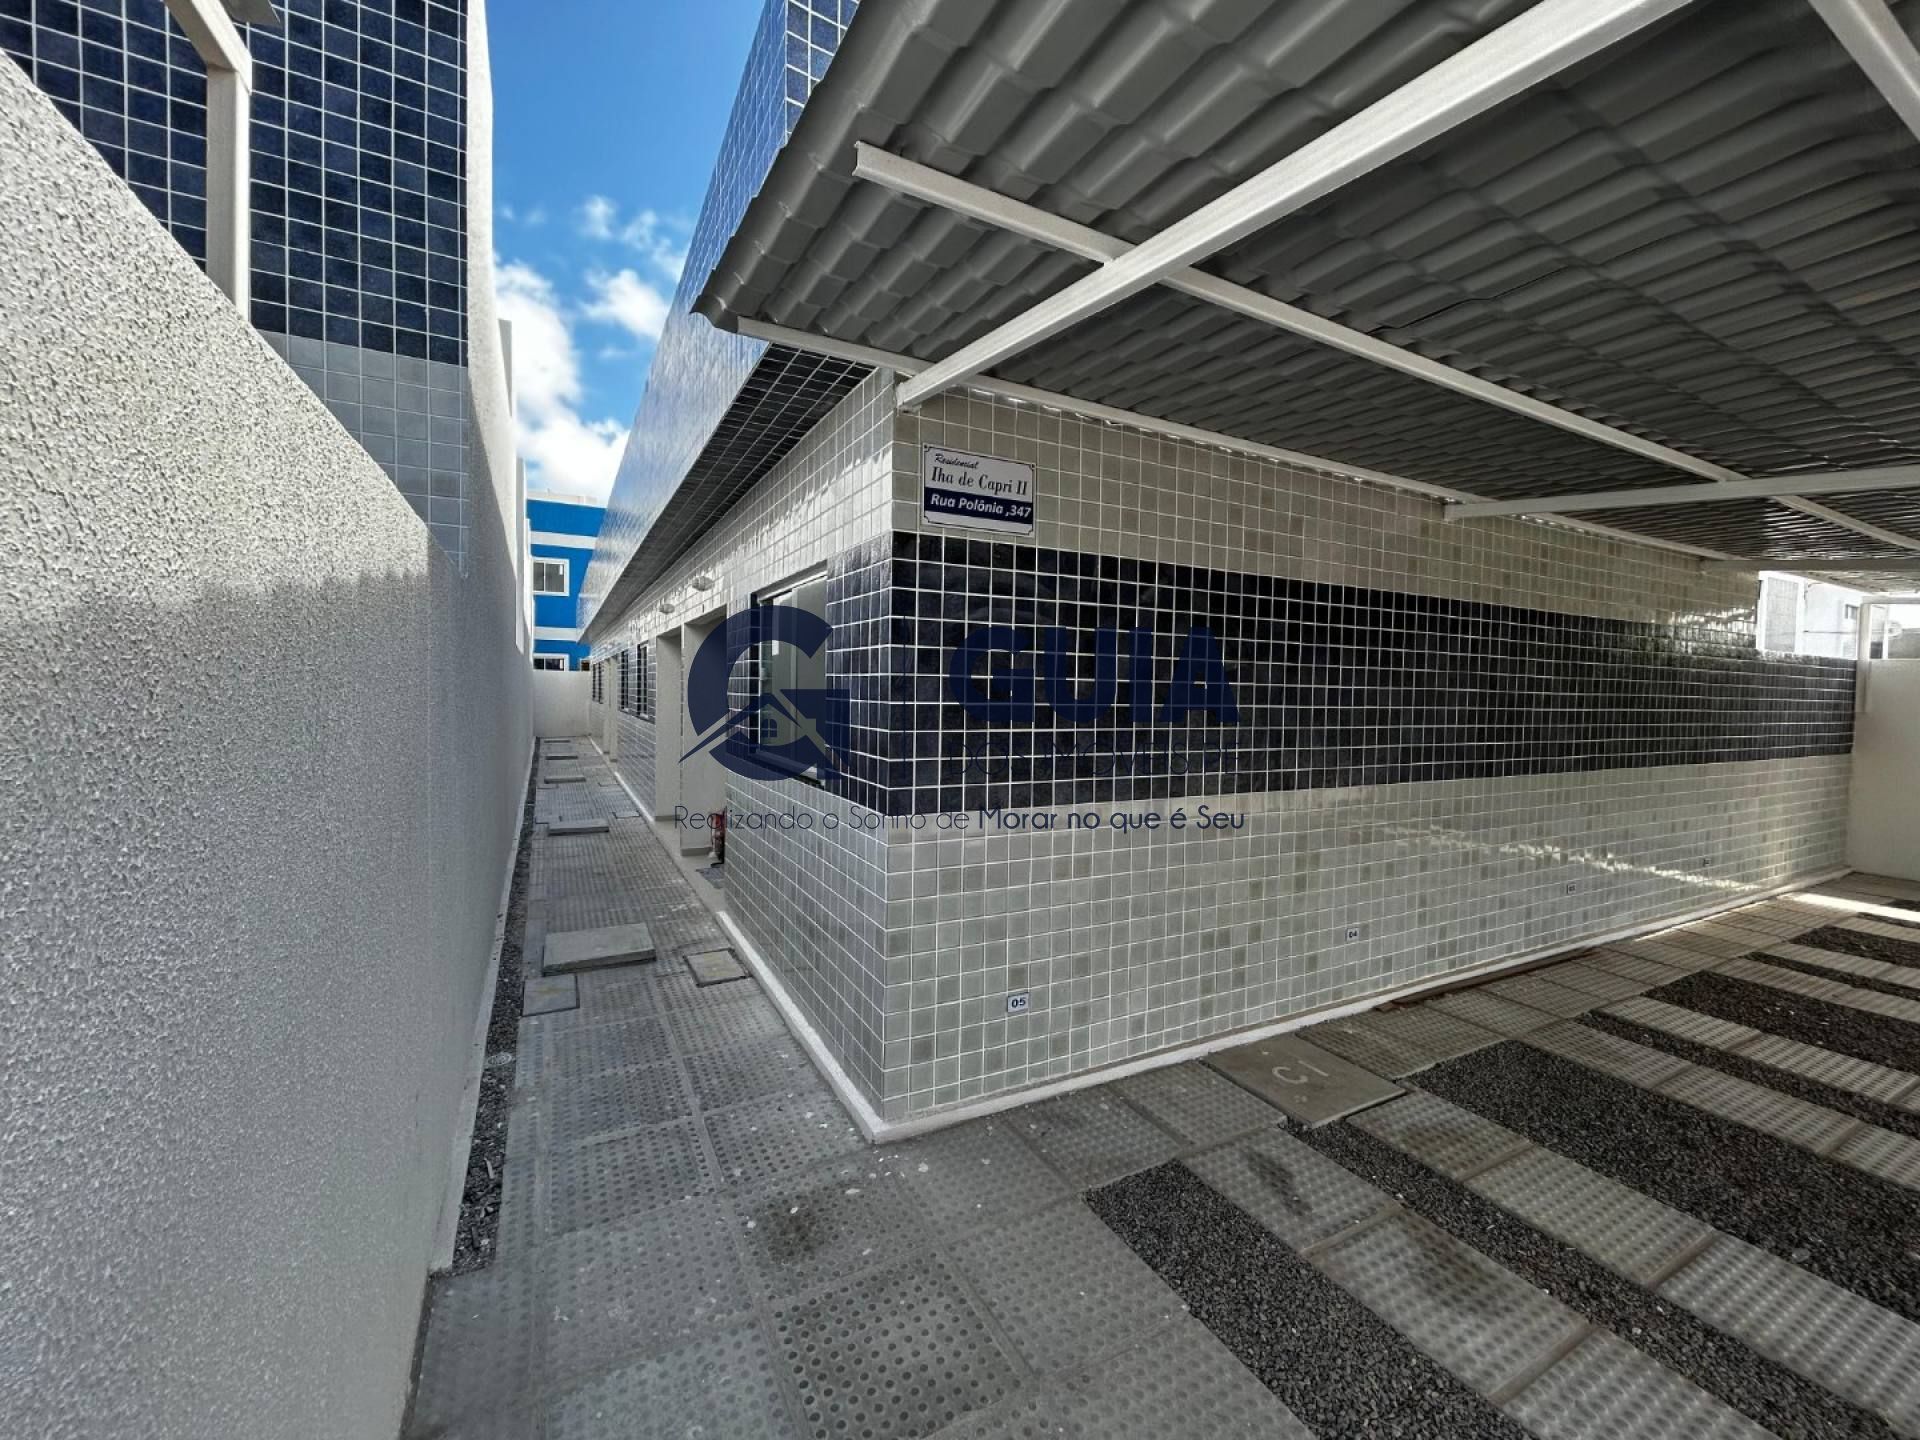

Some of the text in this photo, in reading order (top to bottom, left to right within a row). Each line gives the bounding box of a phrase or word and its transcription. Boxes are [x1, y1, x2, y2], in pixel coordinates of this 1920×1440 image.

[958, 472, 974, 487] de
[979, 474, 1013, 496] Capri
[930, 493, 956, 509] Rua
[958, 497, 1004, 515] Polônia
[1011, 997, 1026, 1008] 05
